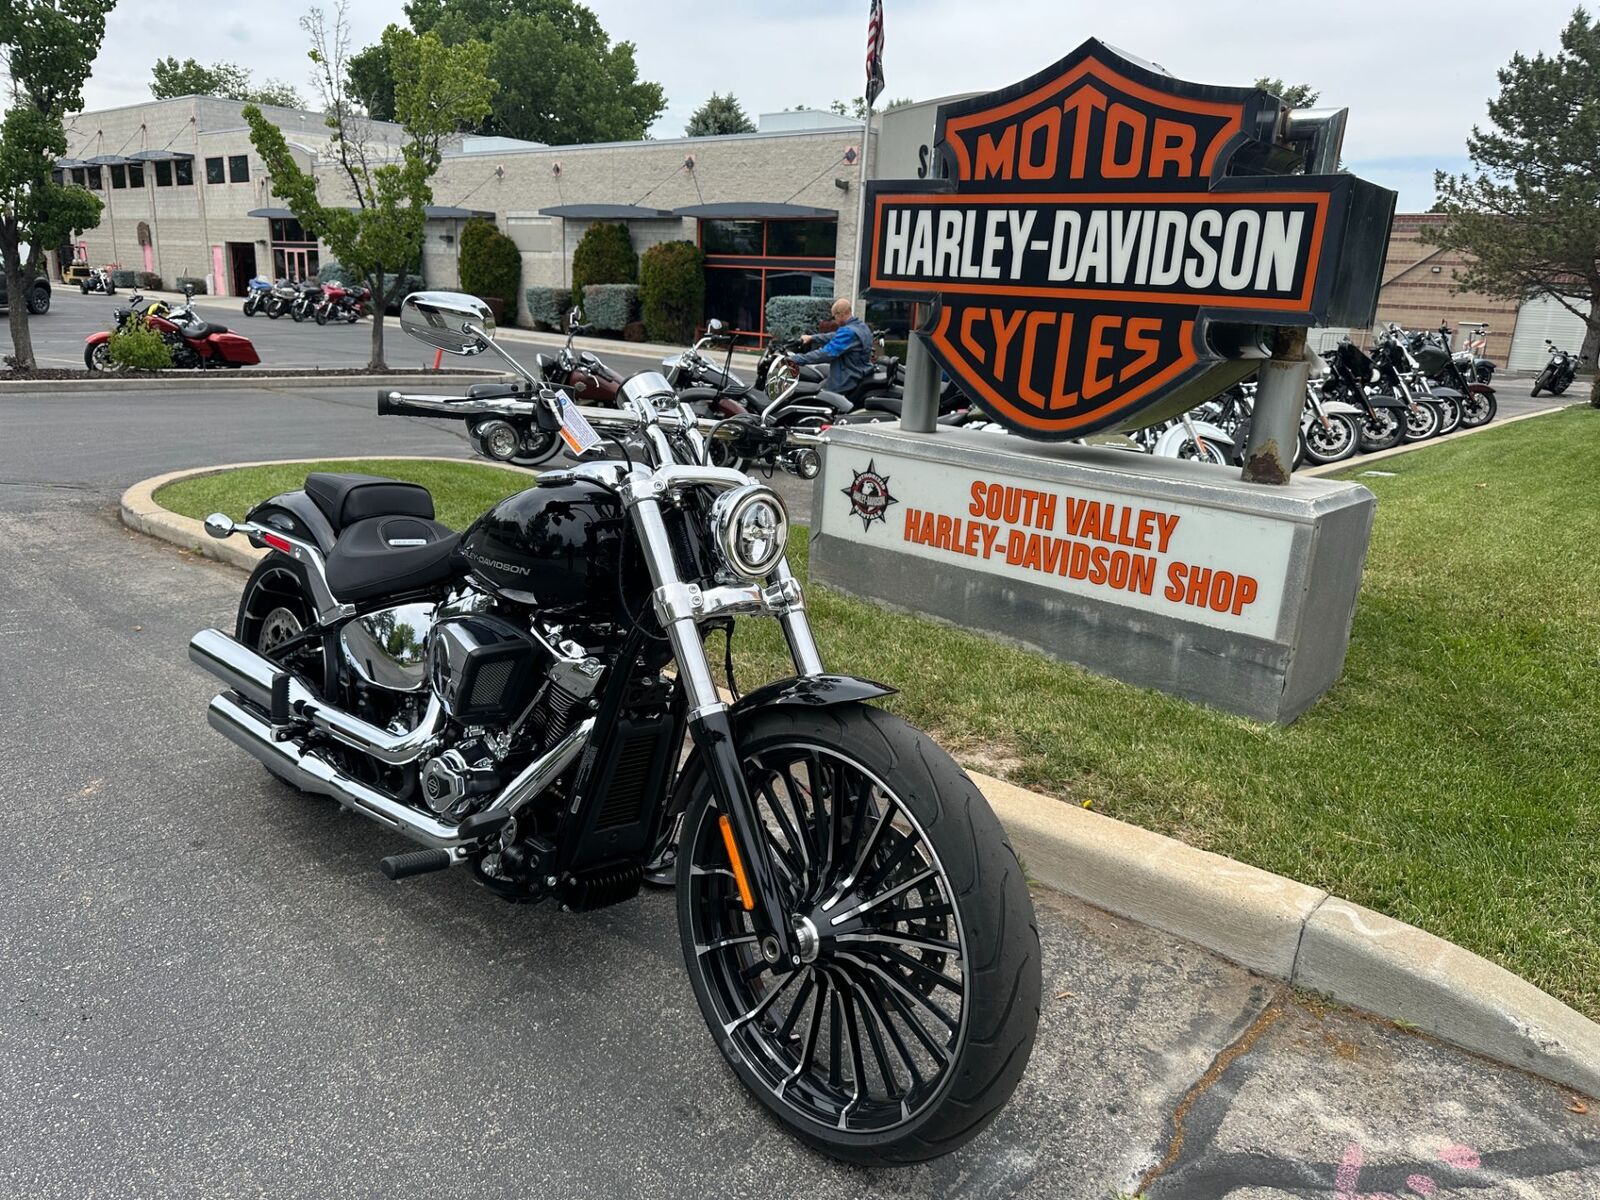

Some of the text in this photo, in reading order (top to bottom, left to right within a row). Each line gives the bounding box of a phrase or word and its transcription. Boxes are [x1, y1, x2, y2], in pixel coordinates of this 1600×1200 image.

[975, 83, 1197, 181] MOTOR
[883, 208, 1305, 292] HARLEY-DAVIDSON
[960, 306, 1160, 411] CYCLES
[903, 508, 1258, 616] HARLEY-DAVIDSON SHOP
[968, 480, 1180, 554] SOUTH VALLEY
